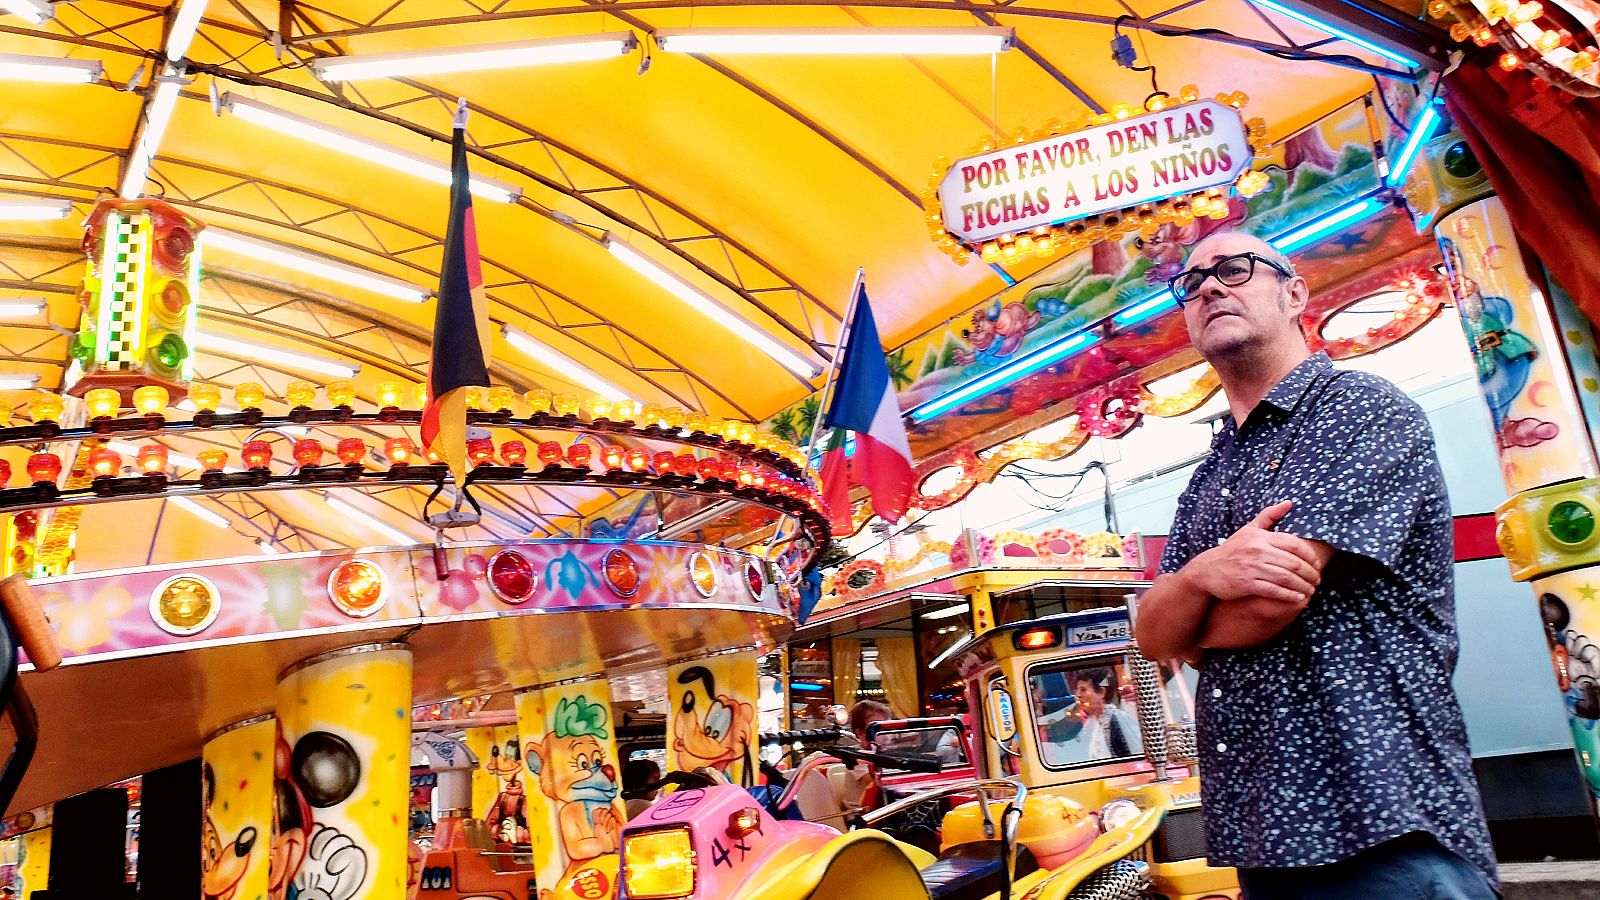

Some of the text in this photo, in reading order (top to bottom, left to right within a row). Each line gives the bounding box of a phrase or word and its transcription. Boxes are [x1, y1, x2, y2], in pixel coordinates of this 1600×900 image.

[961, 107, 1214, 193] POR FAVOR, DEN LAS
[961, 143, 1232, 232] FICHAS A LOS NIÑOS
